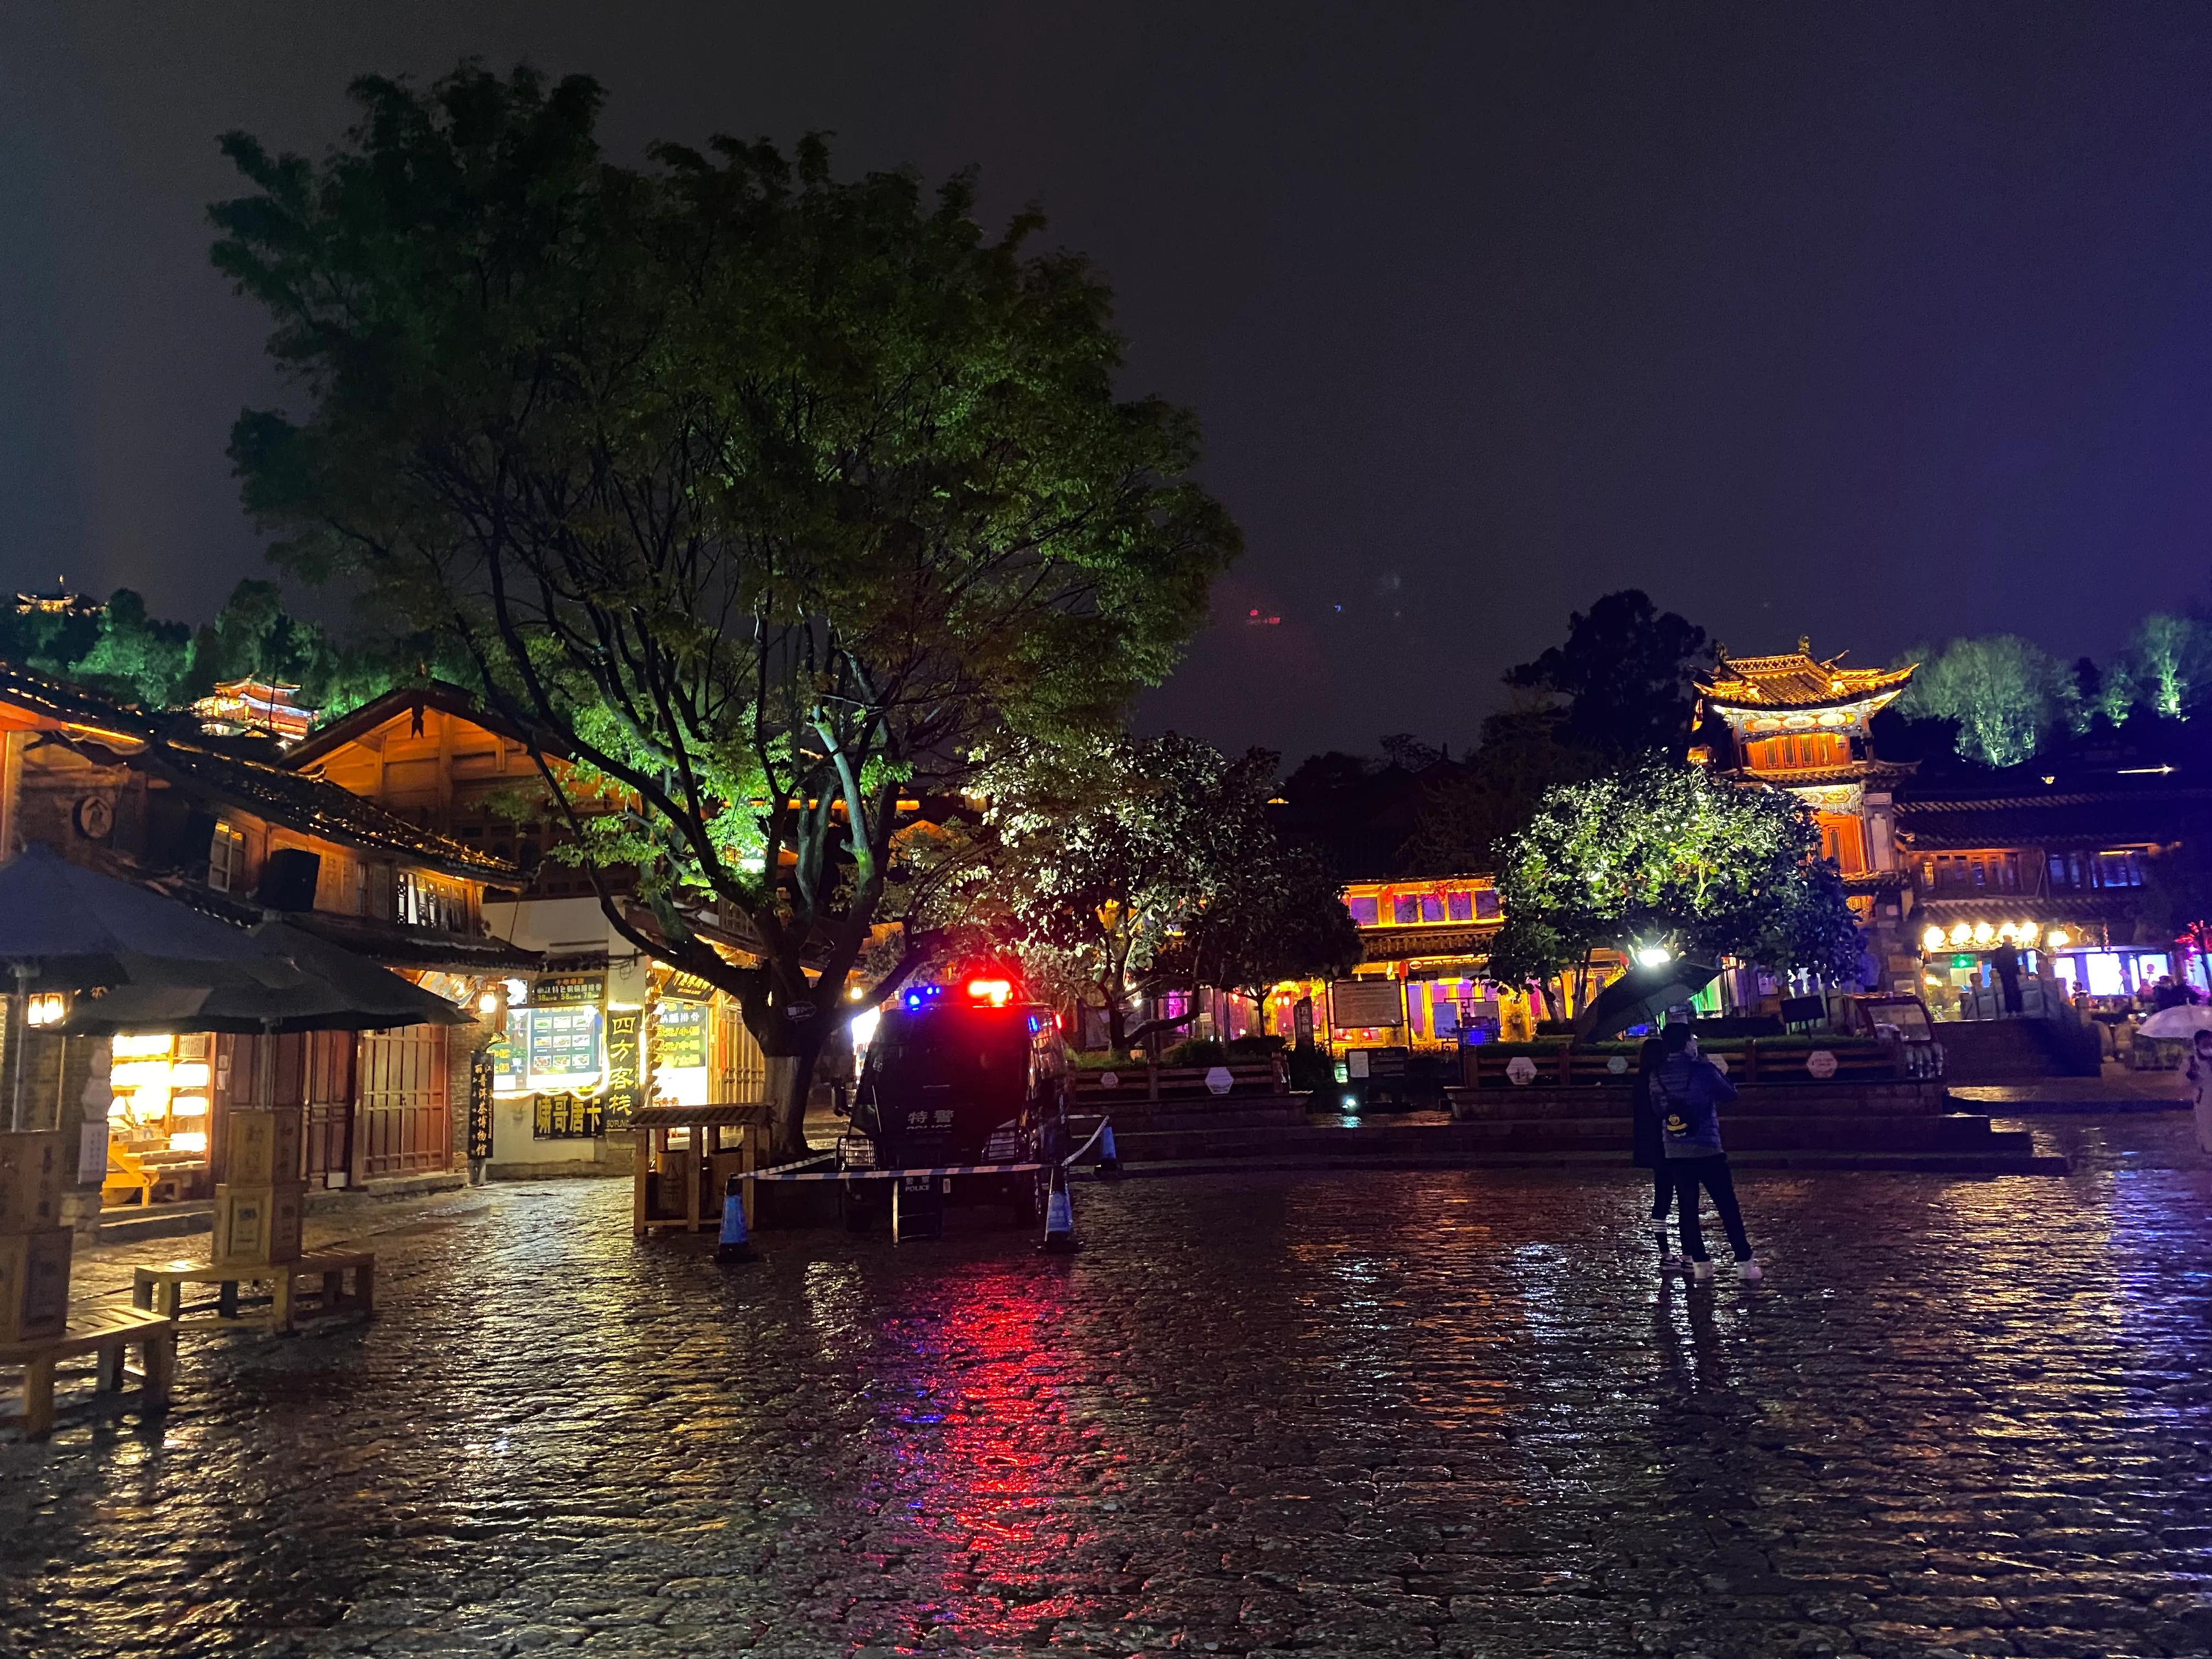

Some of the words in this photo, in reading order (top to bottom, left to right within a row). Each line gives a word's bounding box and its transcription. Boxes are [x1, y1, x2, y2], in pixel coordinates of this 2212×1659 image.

[608, 1017, 636, 1116] 四方客栈
[908, 1110, 955, 1124] 特警
